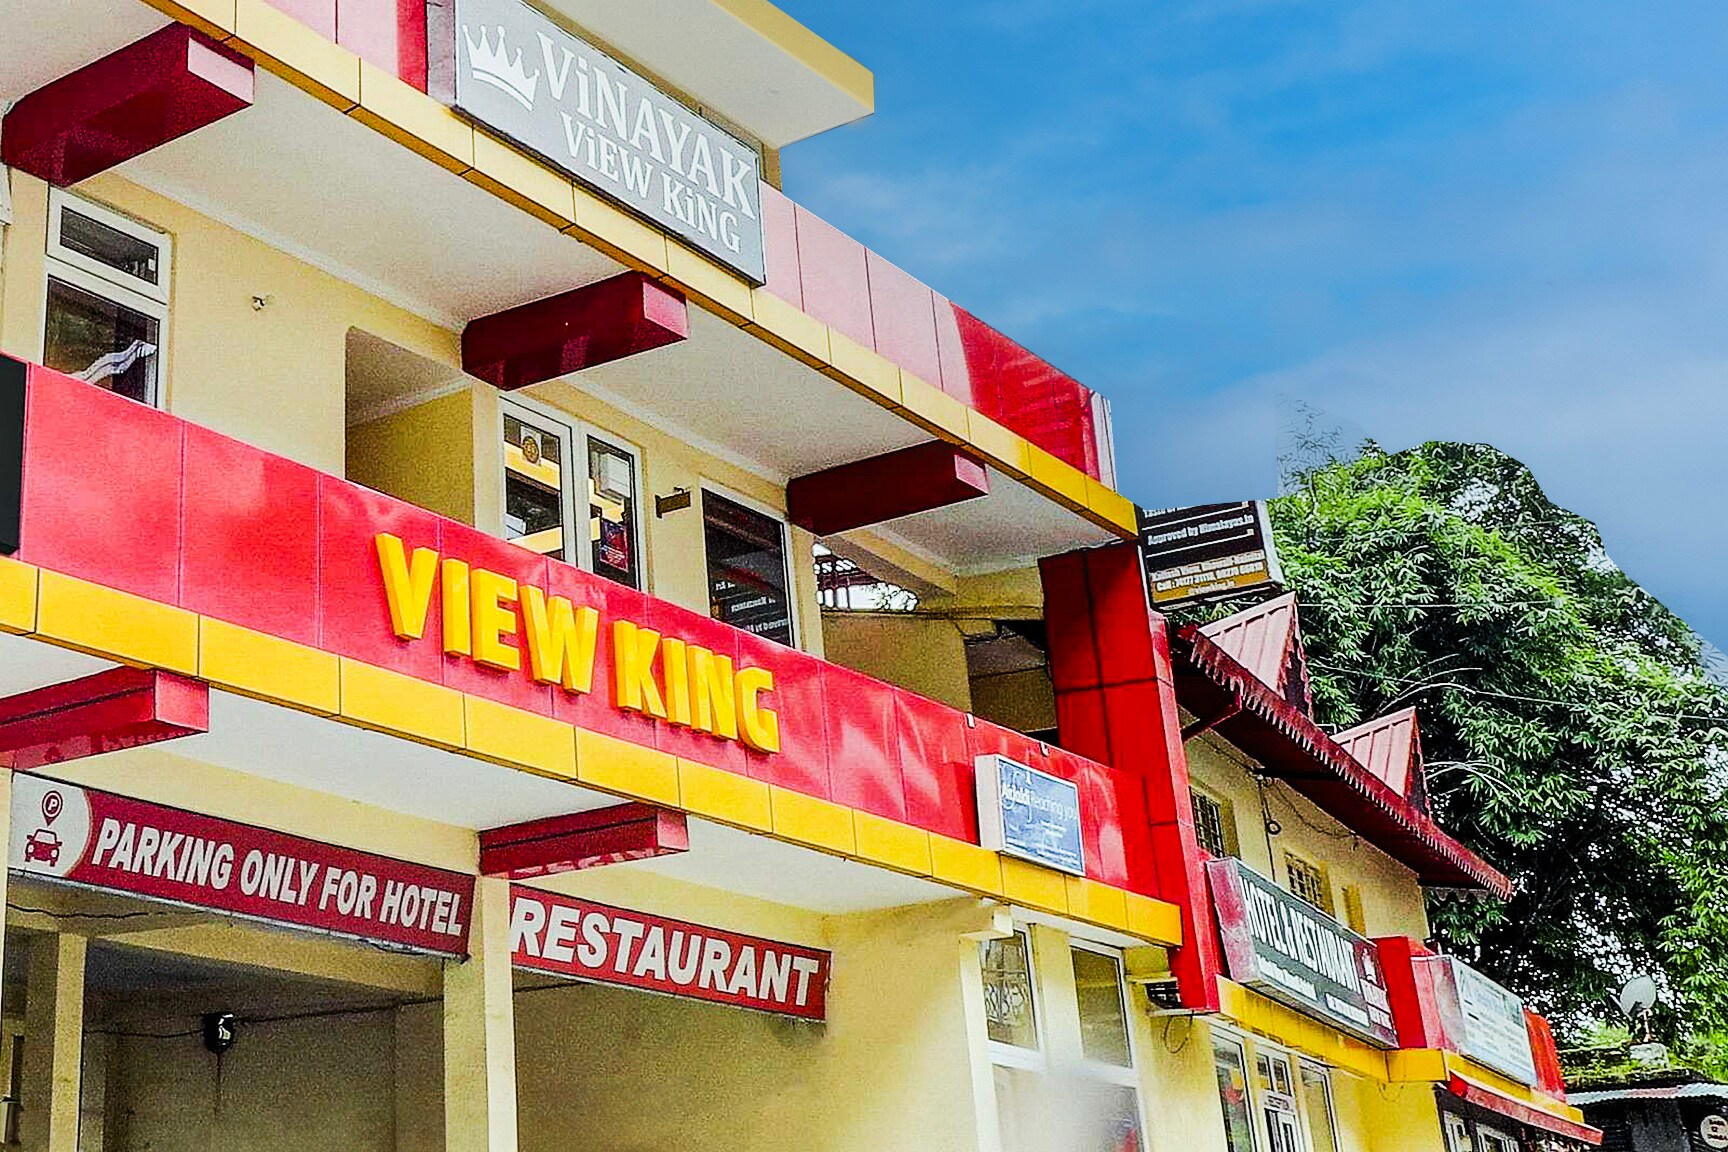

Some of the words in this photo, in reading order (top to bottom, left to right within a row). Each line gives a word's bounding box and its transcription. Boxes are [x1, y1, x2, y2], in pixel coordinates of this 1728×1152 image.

[376, 532, 598, 695] VIEW
[613, 619, 780, 753] KING
[91, 817, 232, 891] PARKING
[240, 849, 322, 907] ONLY
[319, 866, 379, 917] FOR
[380, 879, 462, 937] HOTEL
[1238, 875, 1288, 956] HOTEL
[1288, 906, 1362, 995] RESTAURANT
[509, 899, 819, 1007] RESTAURANT
